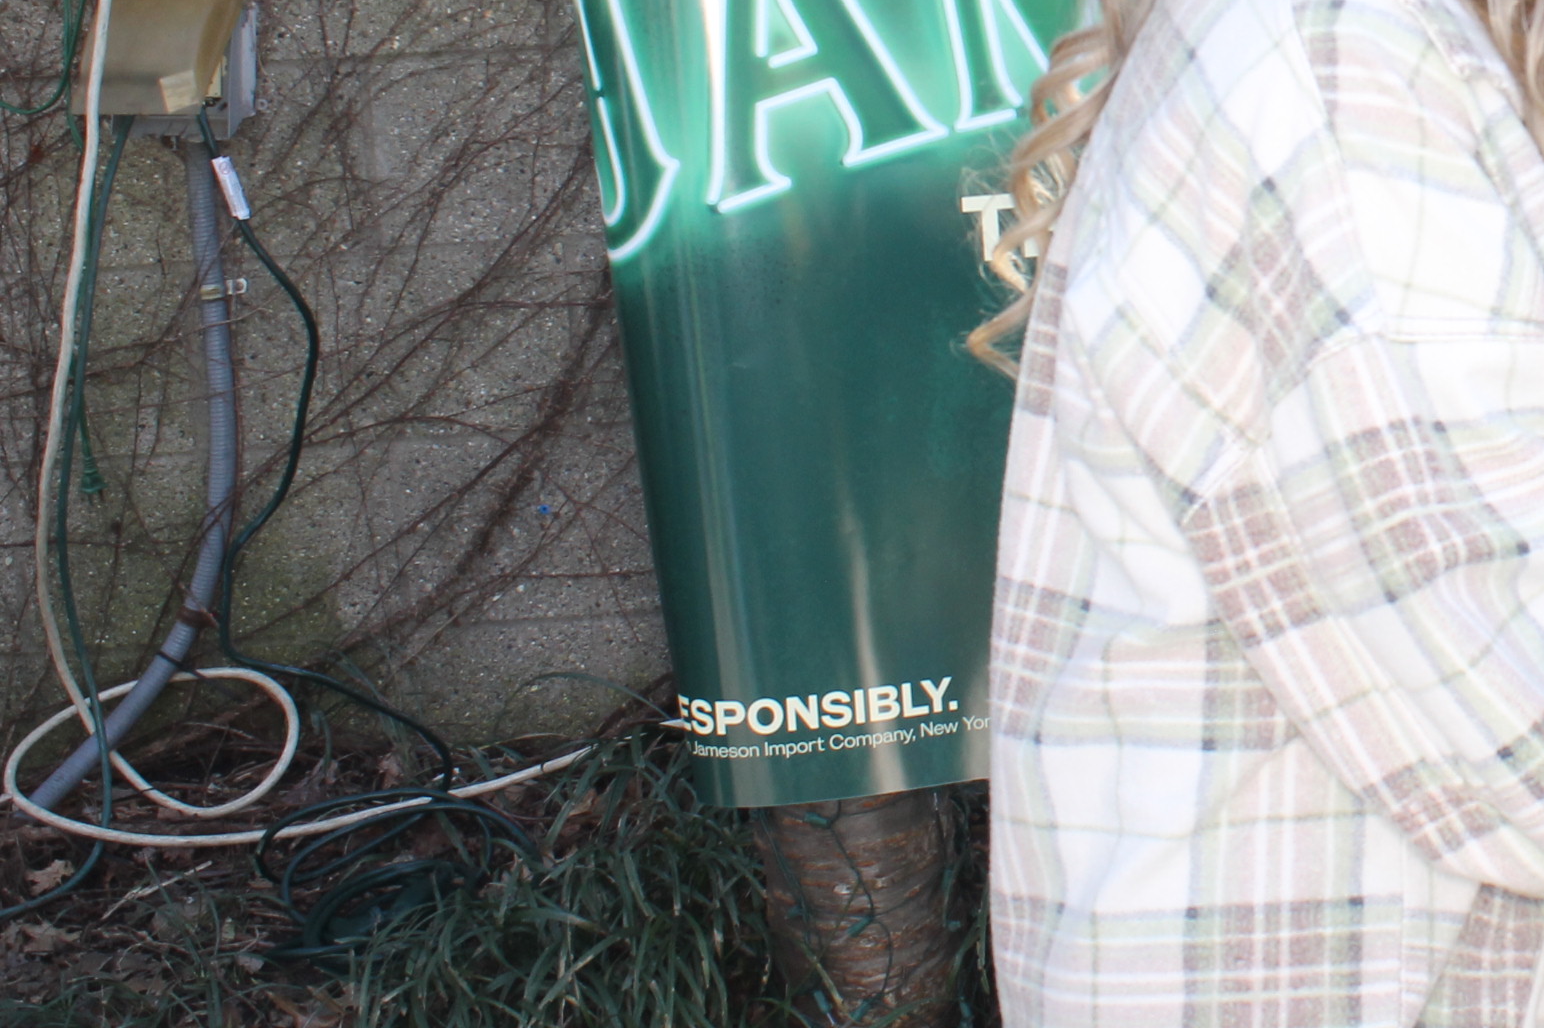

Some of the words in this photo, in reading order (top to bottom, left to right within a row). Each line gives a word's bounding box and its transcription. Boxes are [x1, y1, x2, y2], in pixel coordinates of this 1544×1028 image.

[692, 740, 760, 758] Jameson
[764, 736, 825, 758] Import
[829, 727, 916, 750] Company,
[920, 721, 958, 738] New
